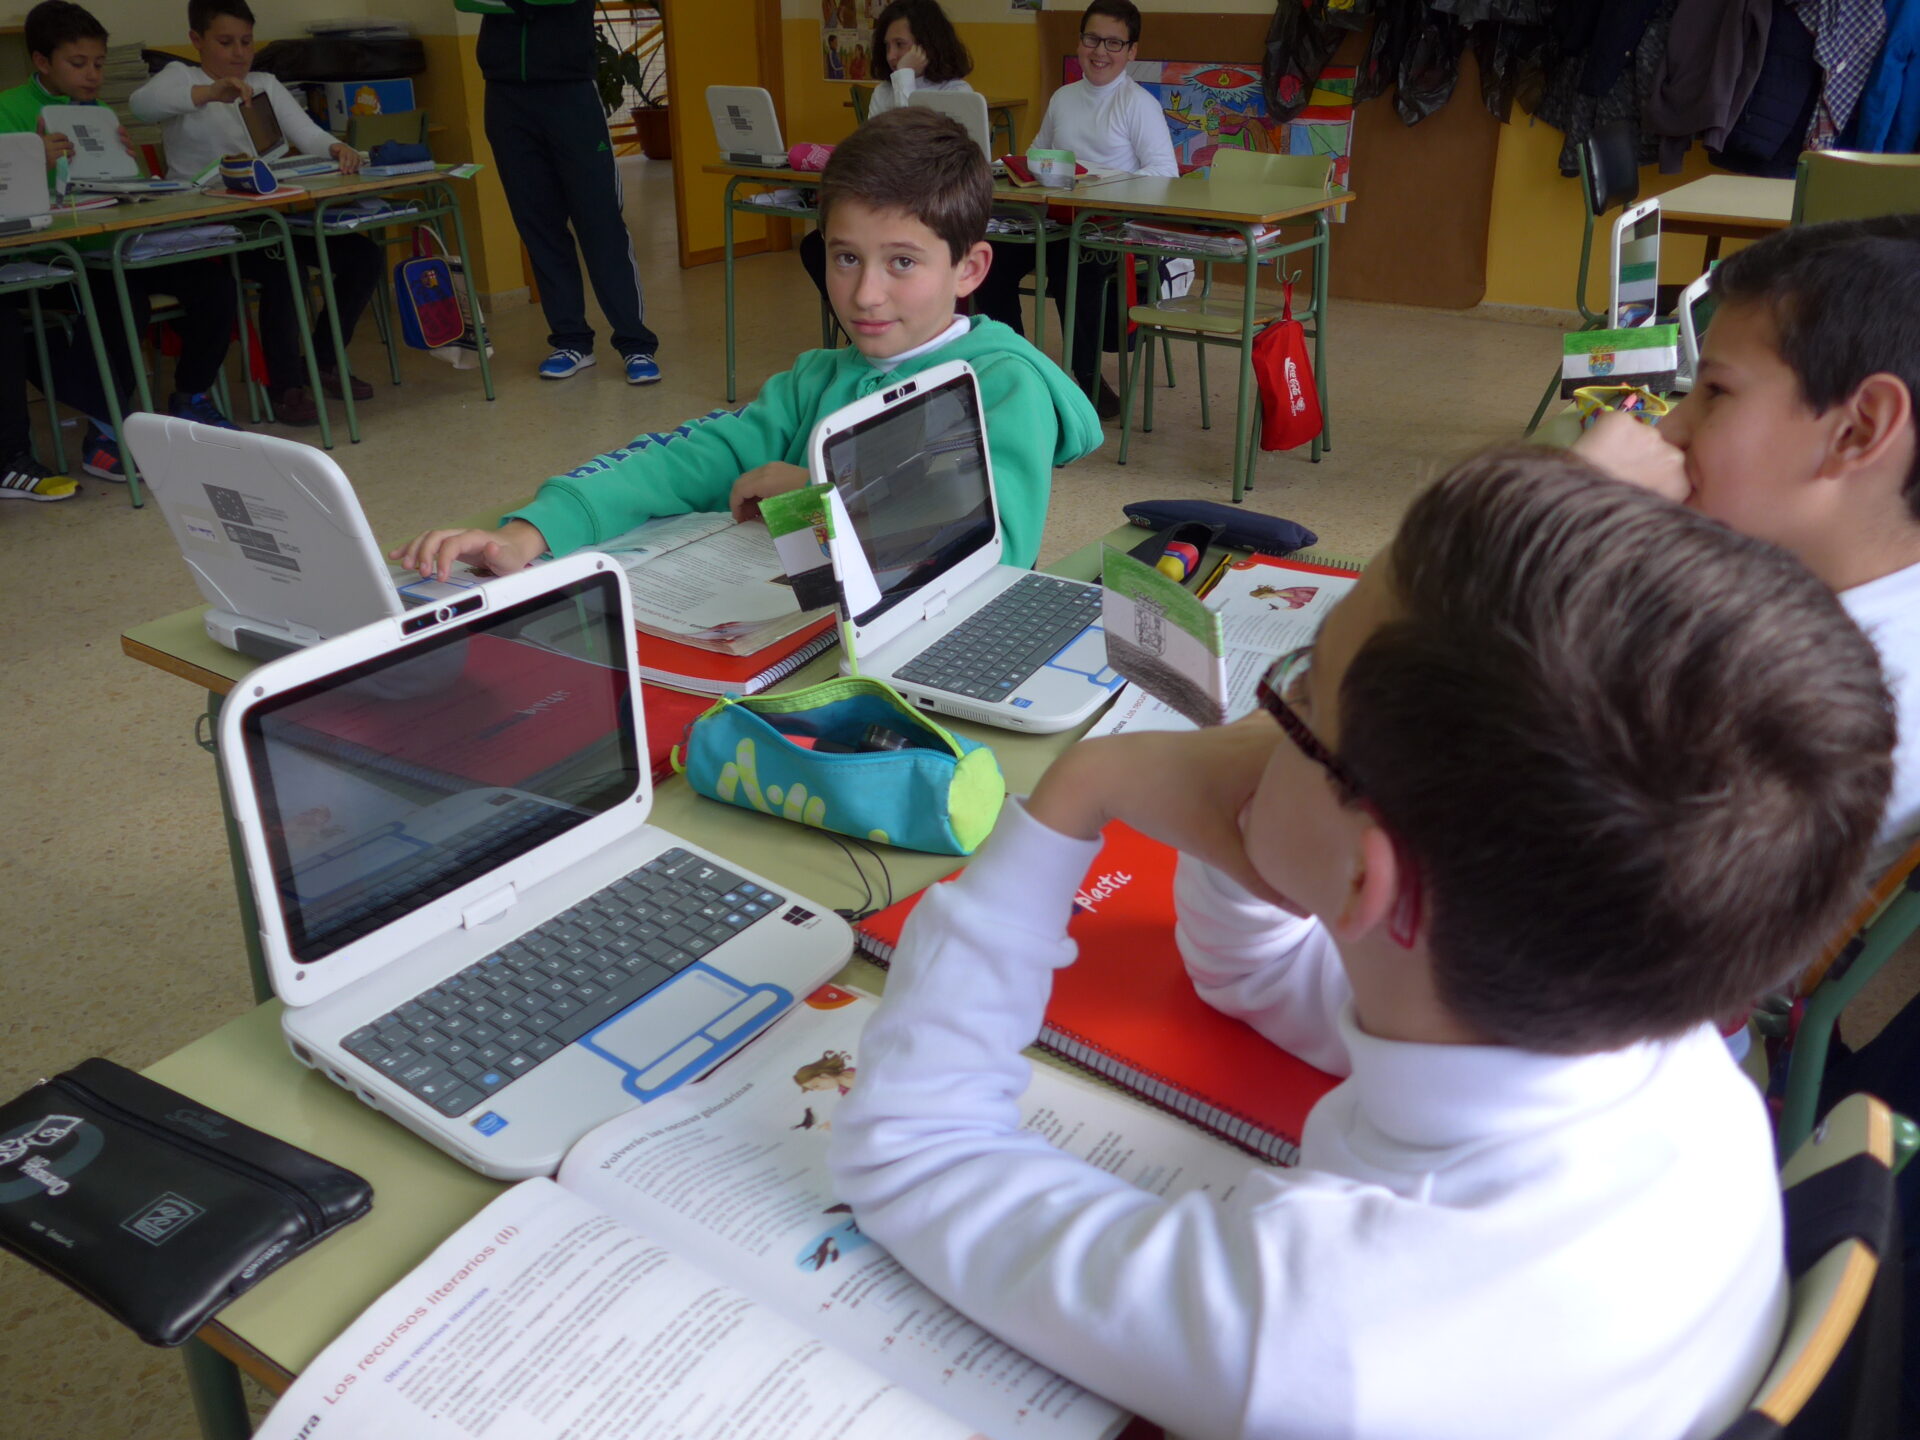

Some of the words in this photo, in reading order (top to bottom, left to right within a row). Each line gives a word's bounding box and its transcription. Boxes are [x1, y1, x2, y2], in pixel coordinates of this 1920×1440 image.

[323, 1373, 355, 1405] Los
[358, 1306, 427, 1370] recursos
[426, 1244, 497, 1306] literarios
